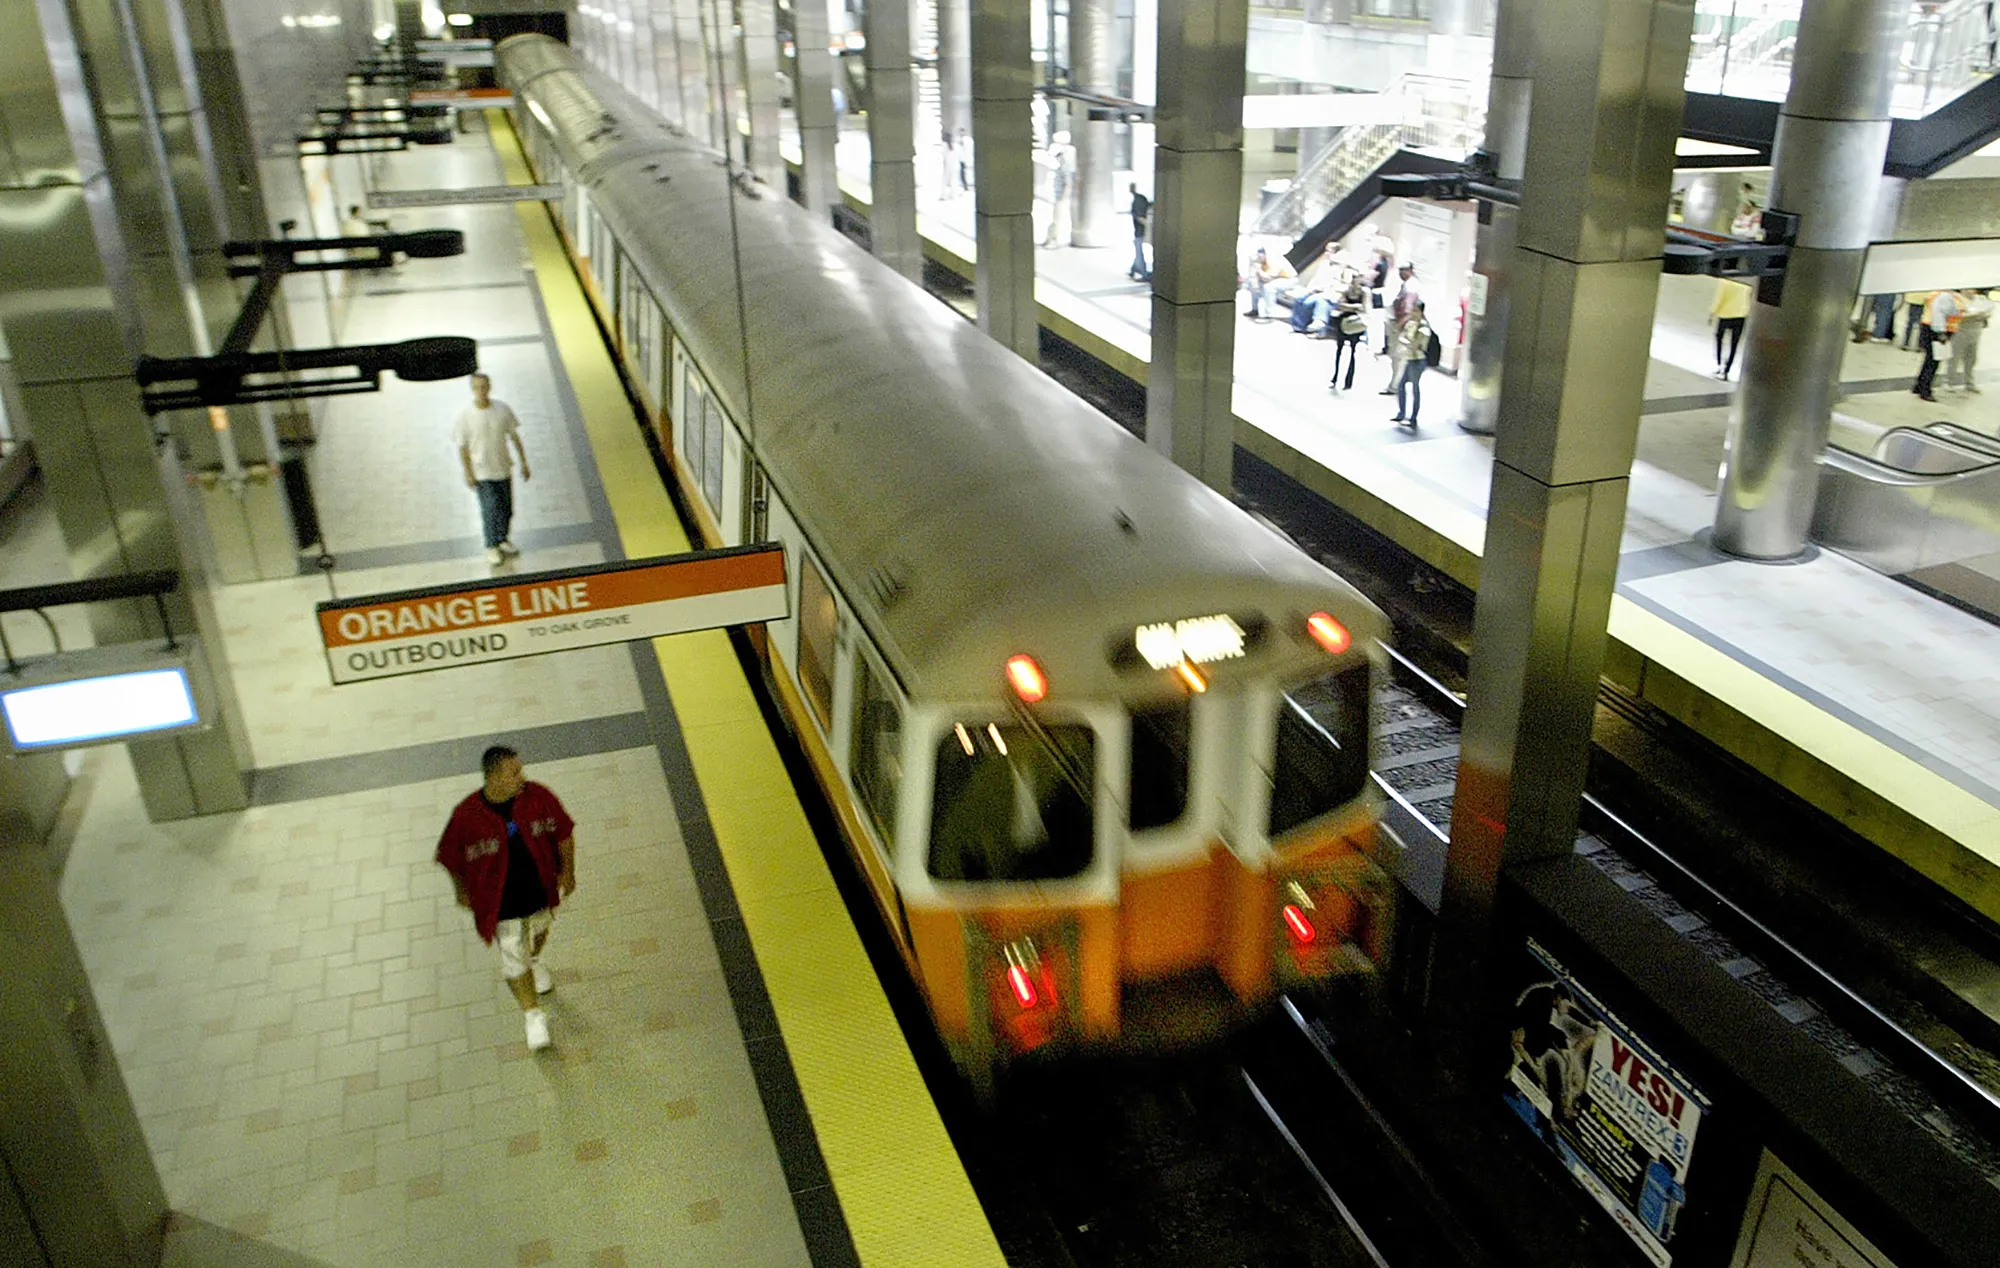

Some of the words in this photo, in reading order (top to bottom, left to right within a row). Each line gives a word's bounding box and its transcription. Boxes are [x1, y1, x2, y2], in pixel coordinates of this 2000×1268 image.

[338, 594, 501, 641] ORANGE
[509, 582, 591, 617] LINE
[348, 633, 507, 671] OUTBOUND
[527, 626, 546, 638] TO
[550, 621, 581, 634] OAK
[582, 614, 632, 630] GROVE
[1610, 1035, 1685, 1130] YES!
